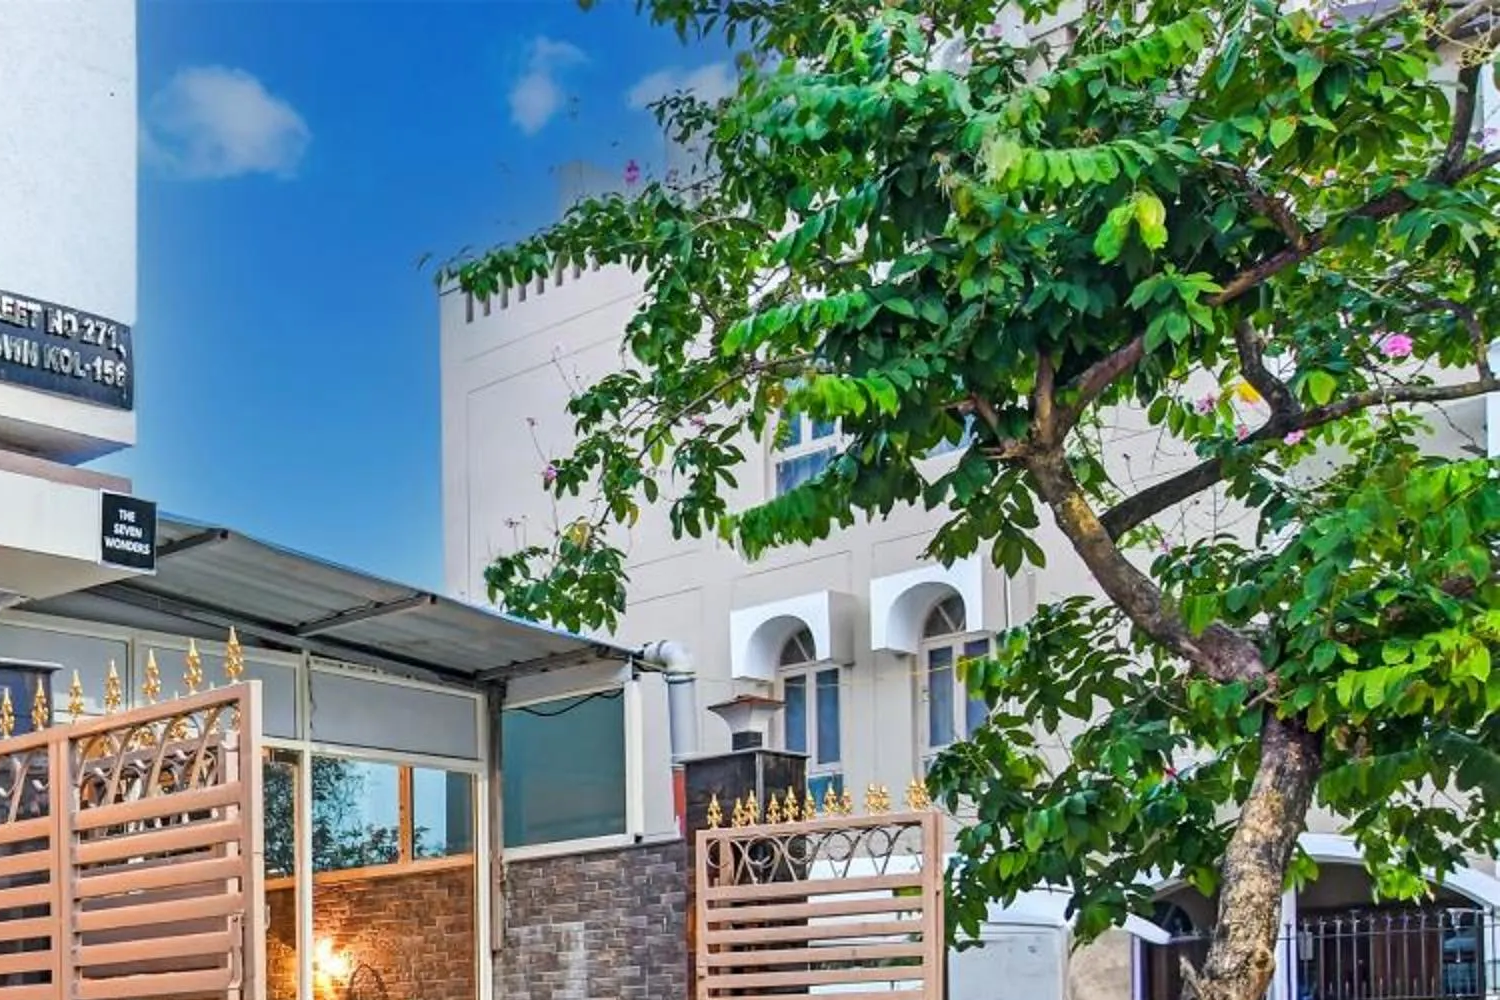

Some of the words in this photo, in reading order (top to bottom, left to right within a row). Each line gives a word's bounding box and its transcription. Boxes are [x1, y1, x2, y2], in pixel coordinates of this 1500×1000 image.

[45, 308, 78, 337] NO
[118, 508, 135, 523] THE
[113, 523, 143, 539] SEVEN
[103, 535, 151, 555] WONDERS
